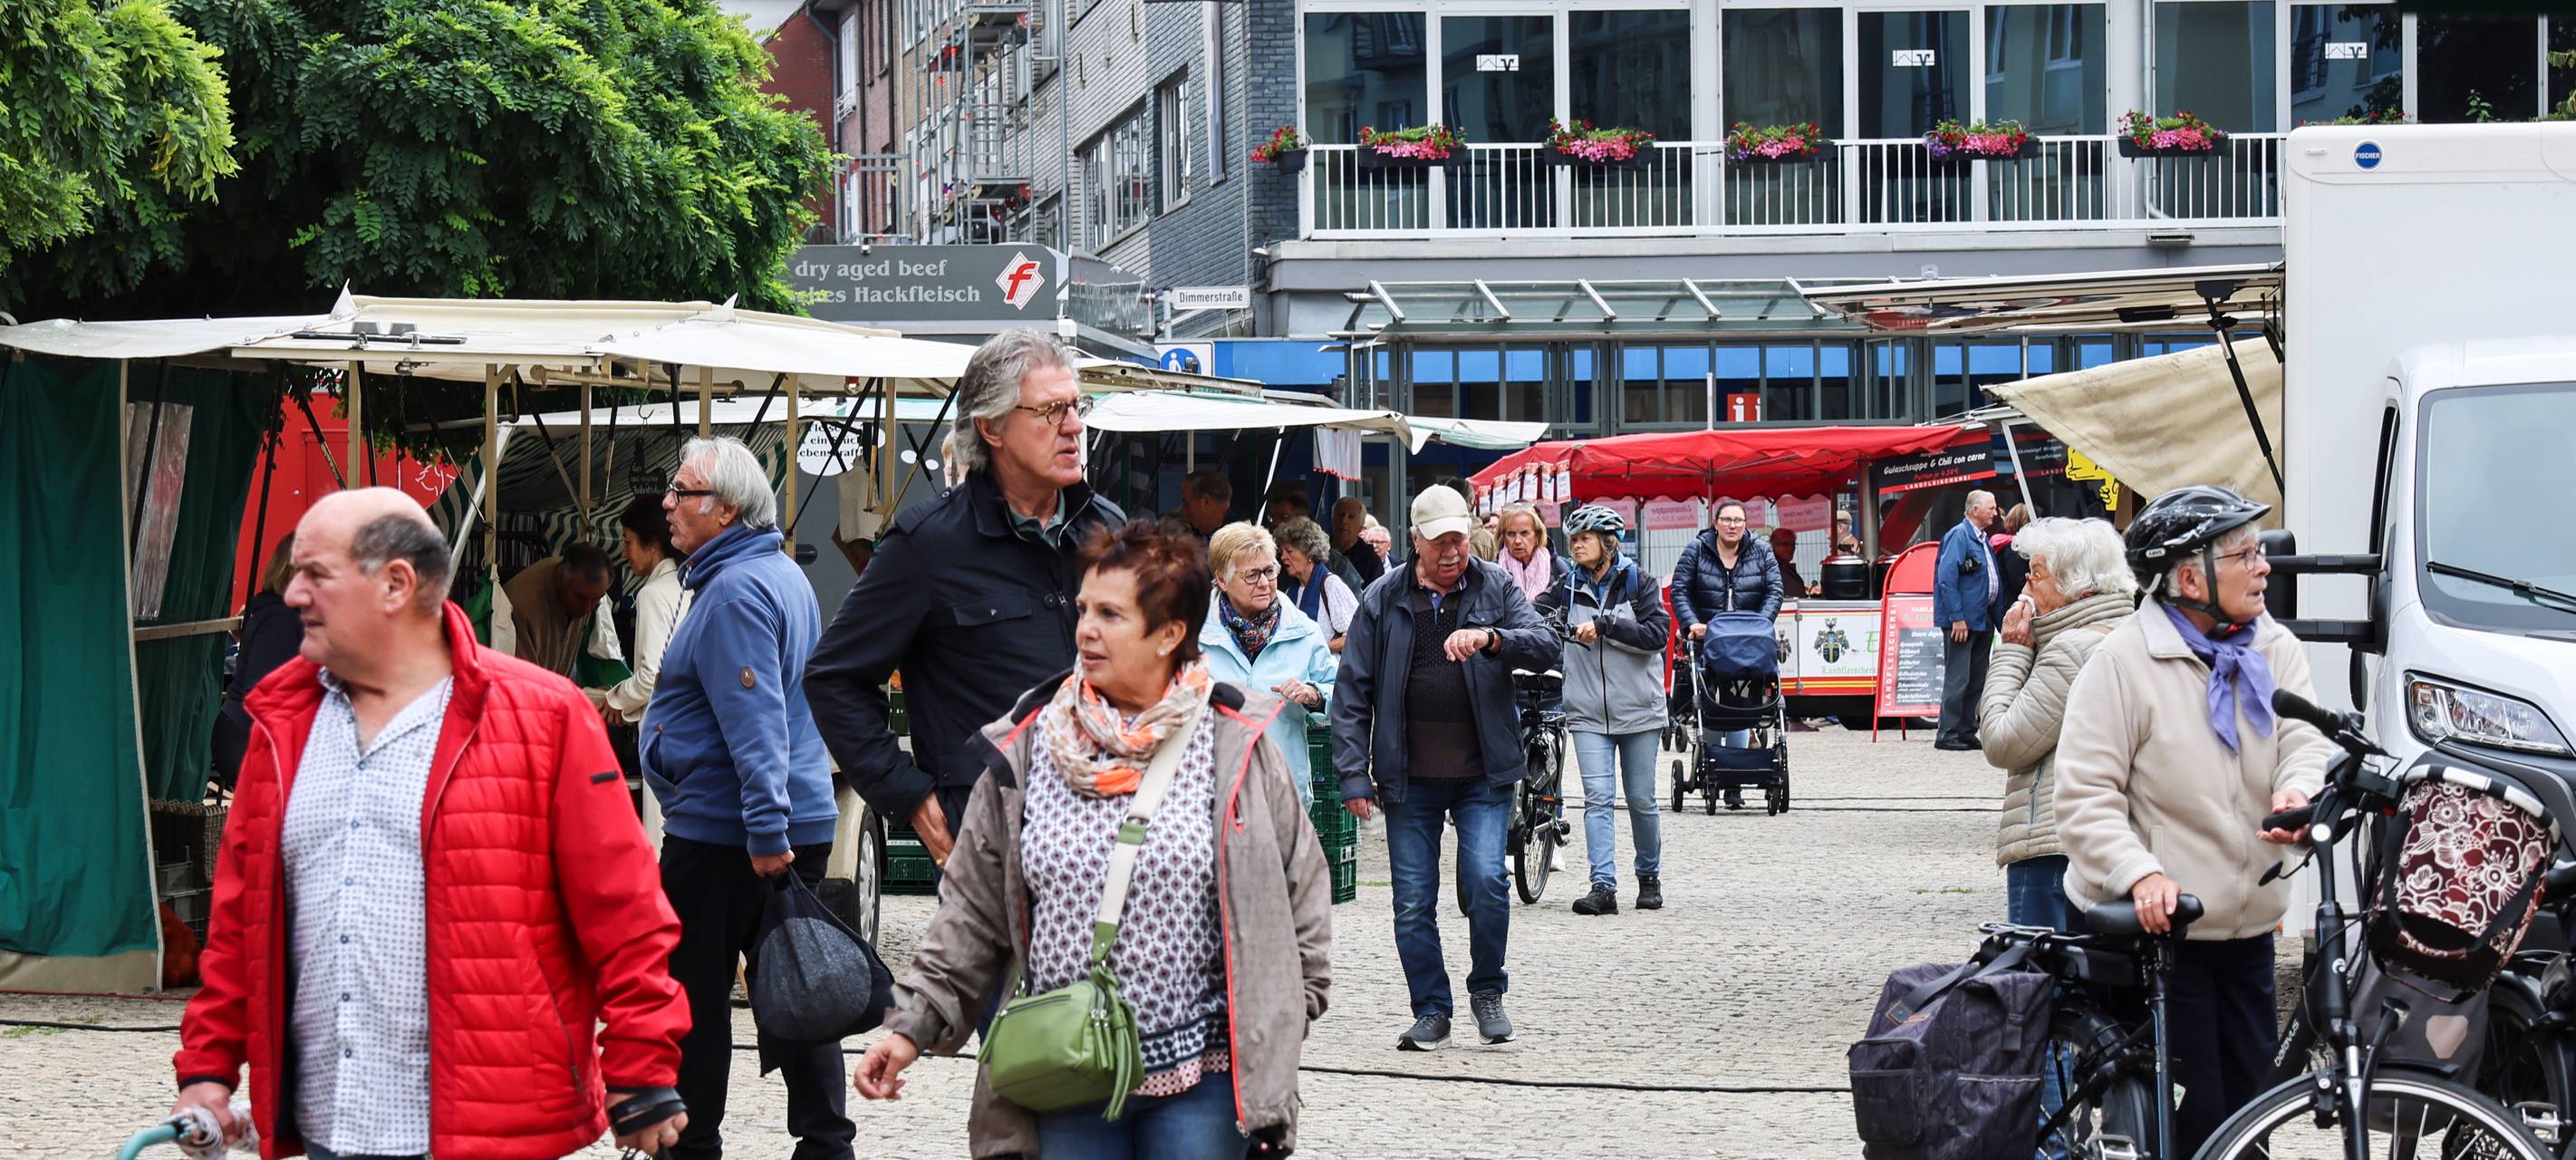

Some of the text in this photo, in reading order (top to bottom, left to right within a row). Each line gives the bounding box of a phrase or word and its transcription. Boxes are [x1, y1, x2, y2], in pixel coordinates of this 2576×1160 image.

[795, 259, 948, 282] dry aged beef
[854, 285, 980, 304] Hackfleisch
[1179, 291, 1244, 304] Dimmerstraße
[810, 436, 827, 444] ein
[1884, 452, 1986, 475] Gulaschsuppe & Chili con carne
[1905, 475, 1971, 490] LANDFLEISCHEREI
[1885, 604, 1898, 707] LANDFLEISCHEREI
[2274, 1019, 2299, 1067] batavus
